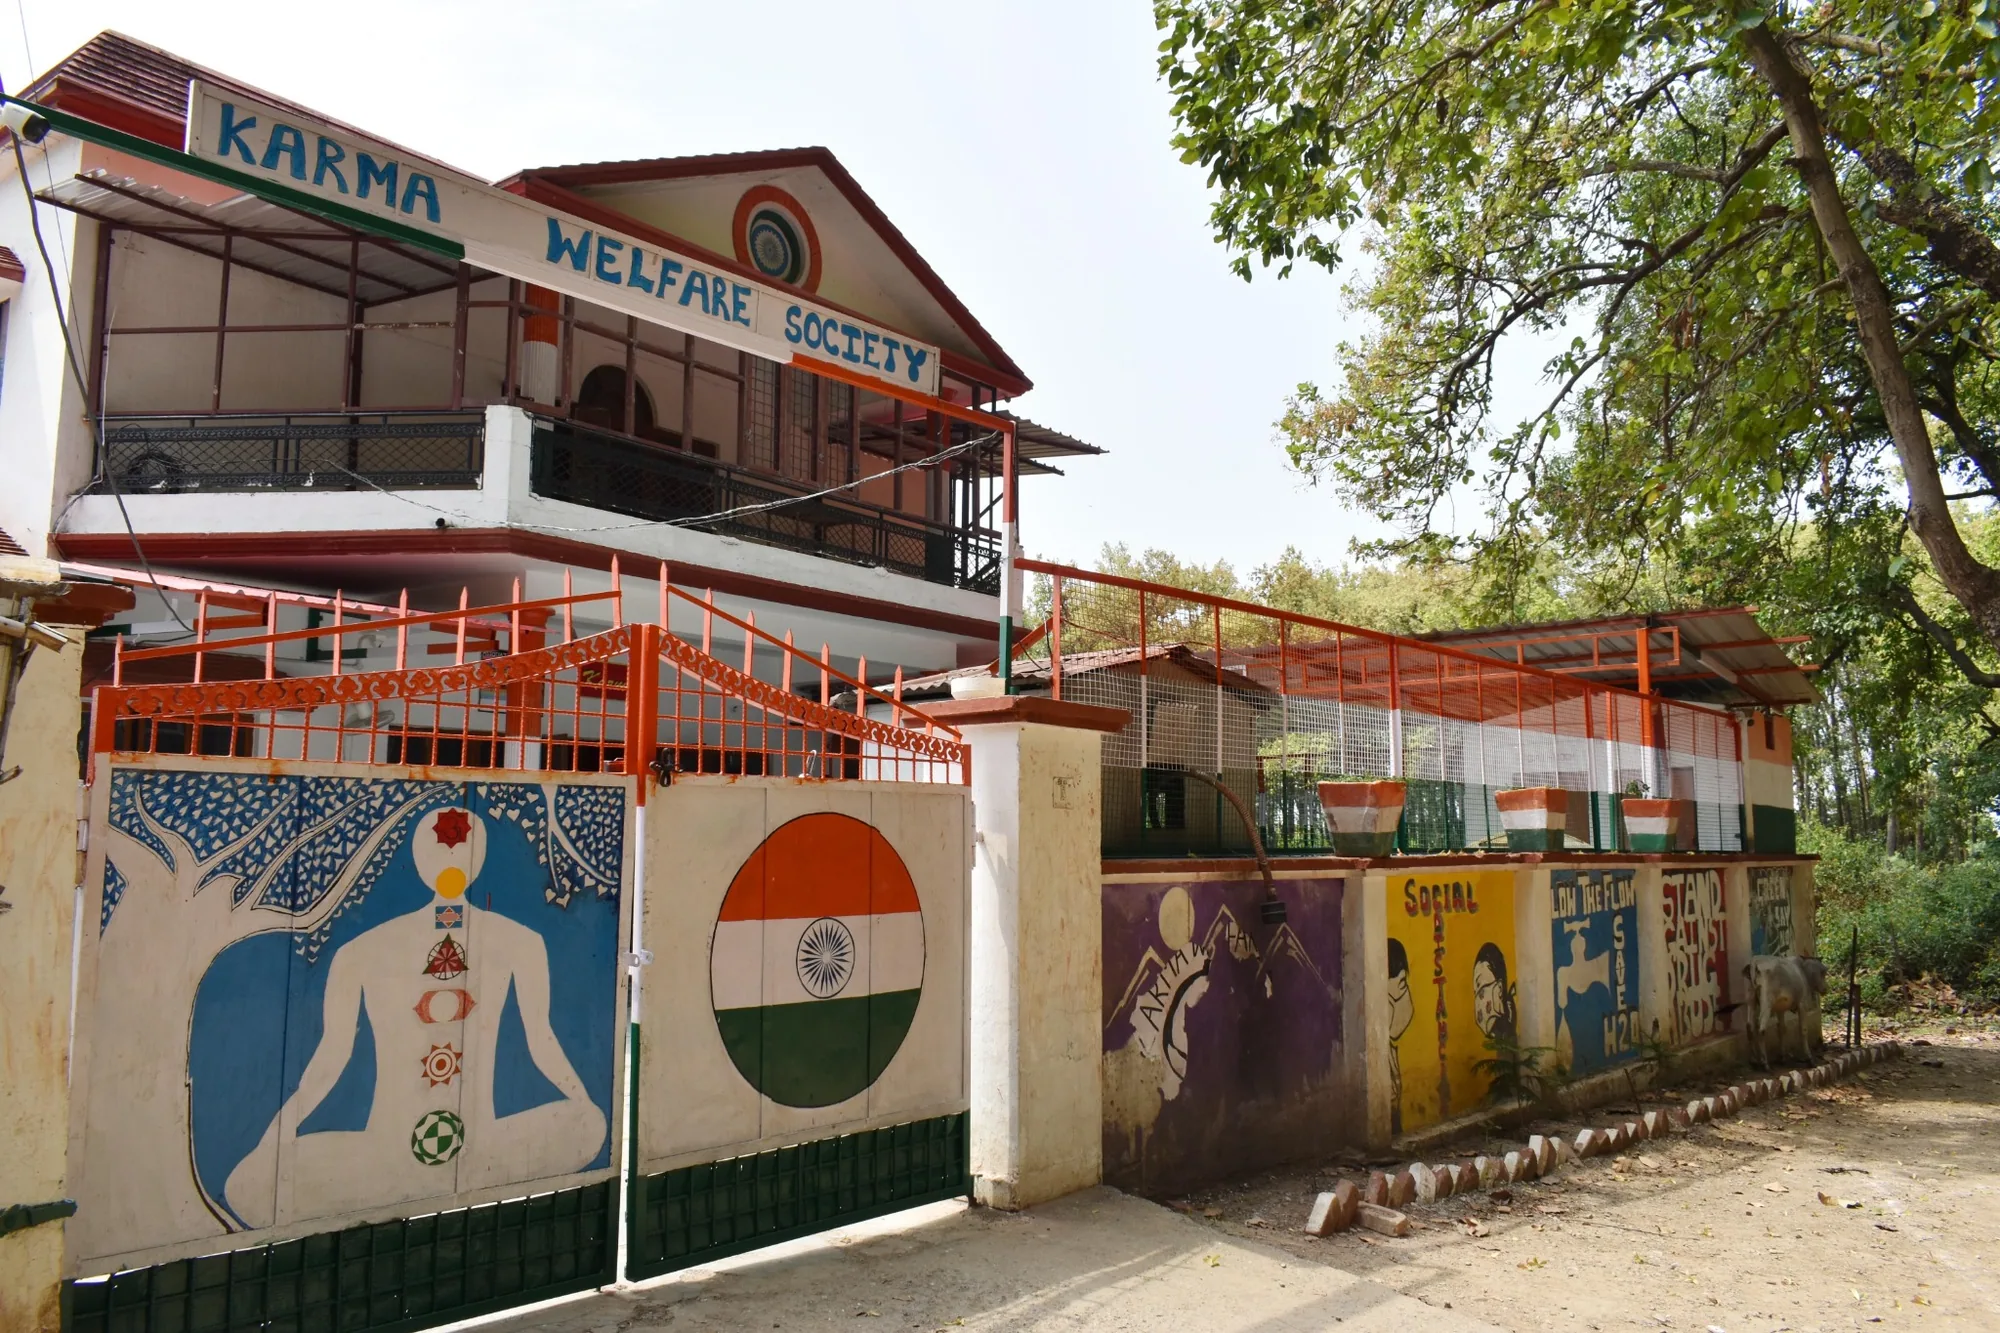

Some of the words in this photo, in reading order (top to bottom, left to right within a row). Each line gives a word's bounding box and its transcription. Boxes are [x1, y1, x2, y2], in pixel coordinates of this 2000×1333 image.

[218, 103, 441, 223] KARMA
[546, 217, 751, 327] WELFARE
[785, 305, 927, 382] SOCIETY
[1404, 878, 1480, 917] SOCIAL
[1551, 886, 1576, 919] LOW
[1577, 875, 1602, 915] THE
[1602, 873, 1636, 911] FLOW
[1661, 869, 1722, 921] STAND
[1664, 914, 1727, 955] GAINST
[1613, 914, 1627, 1011] SAVE
